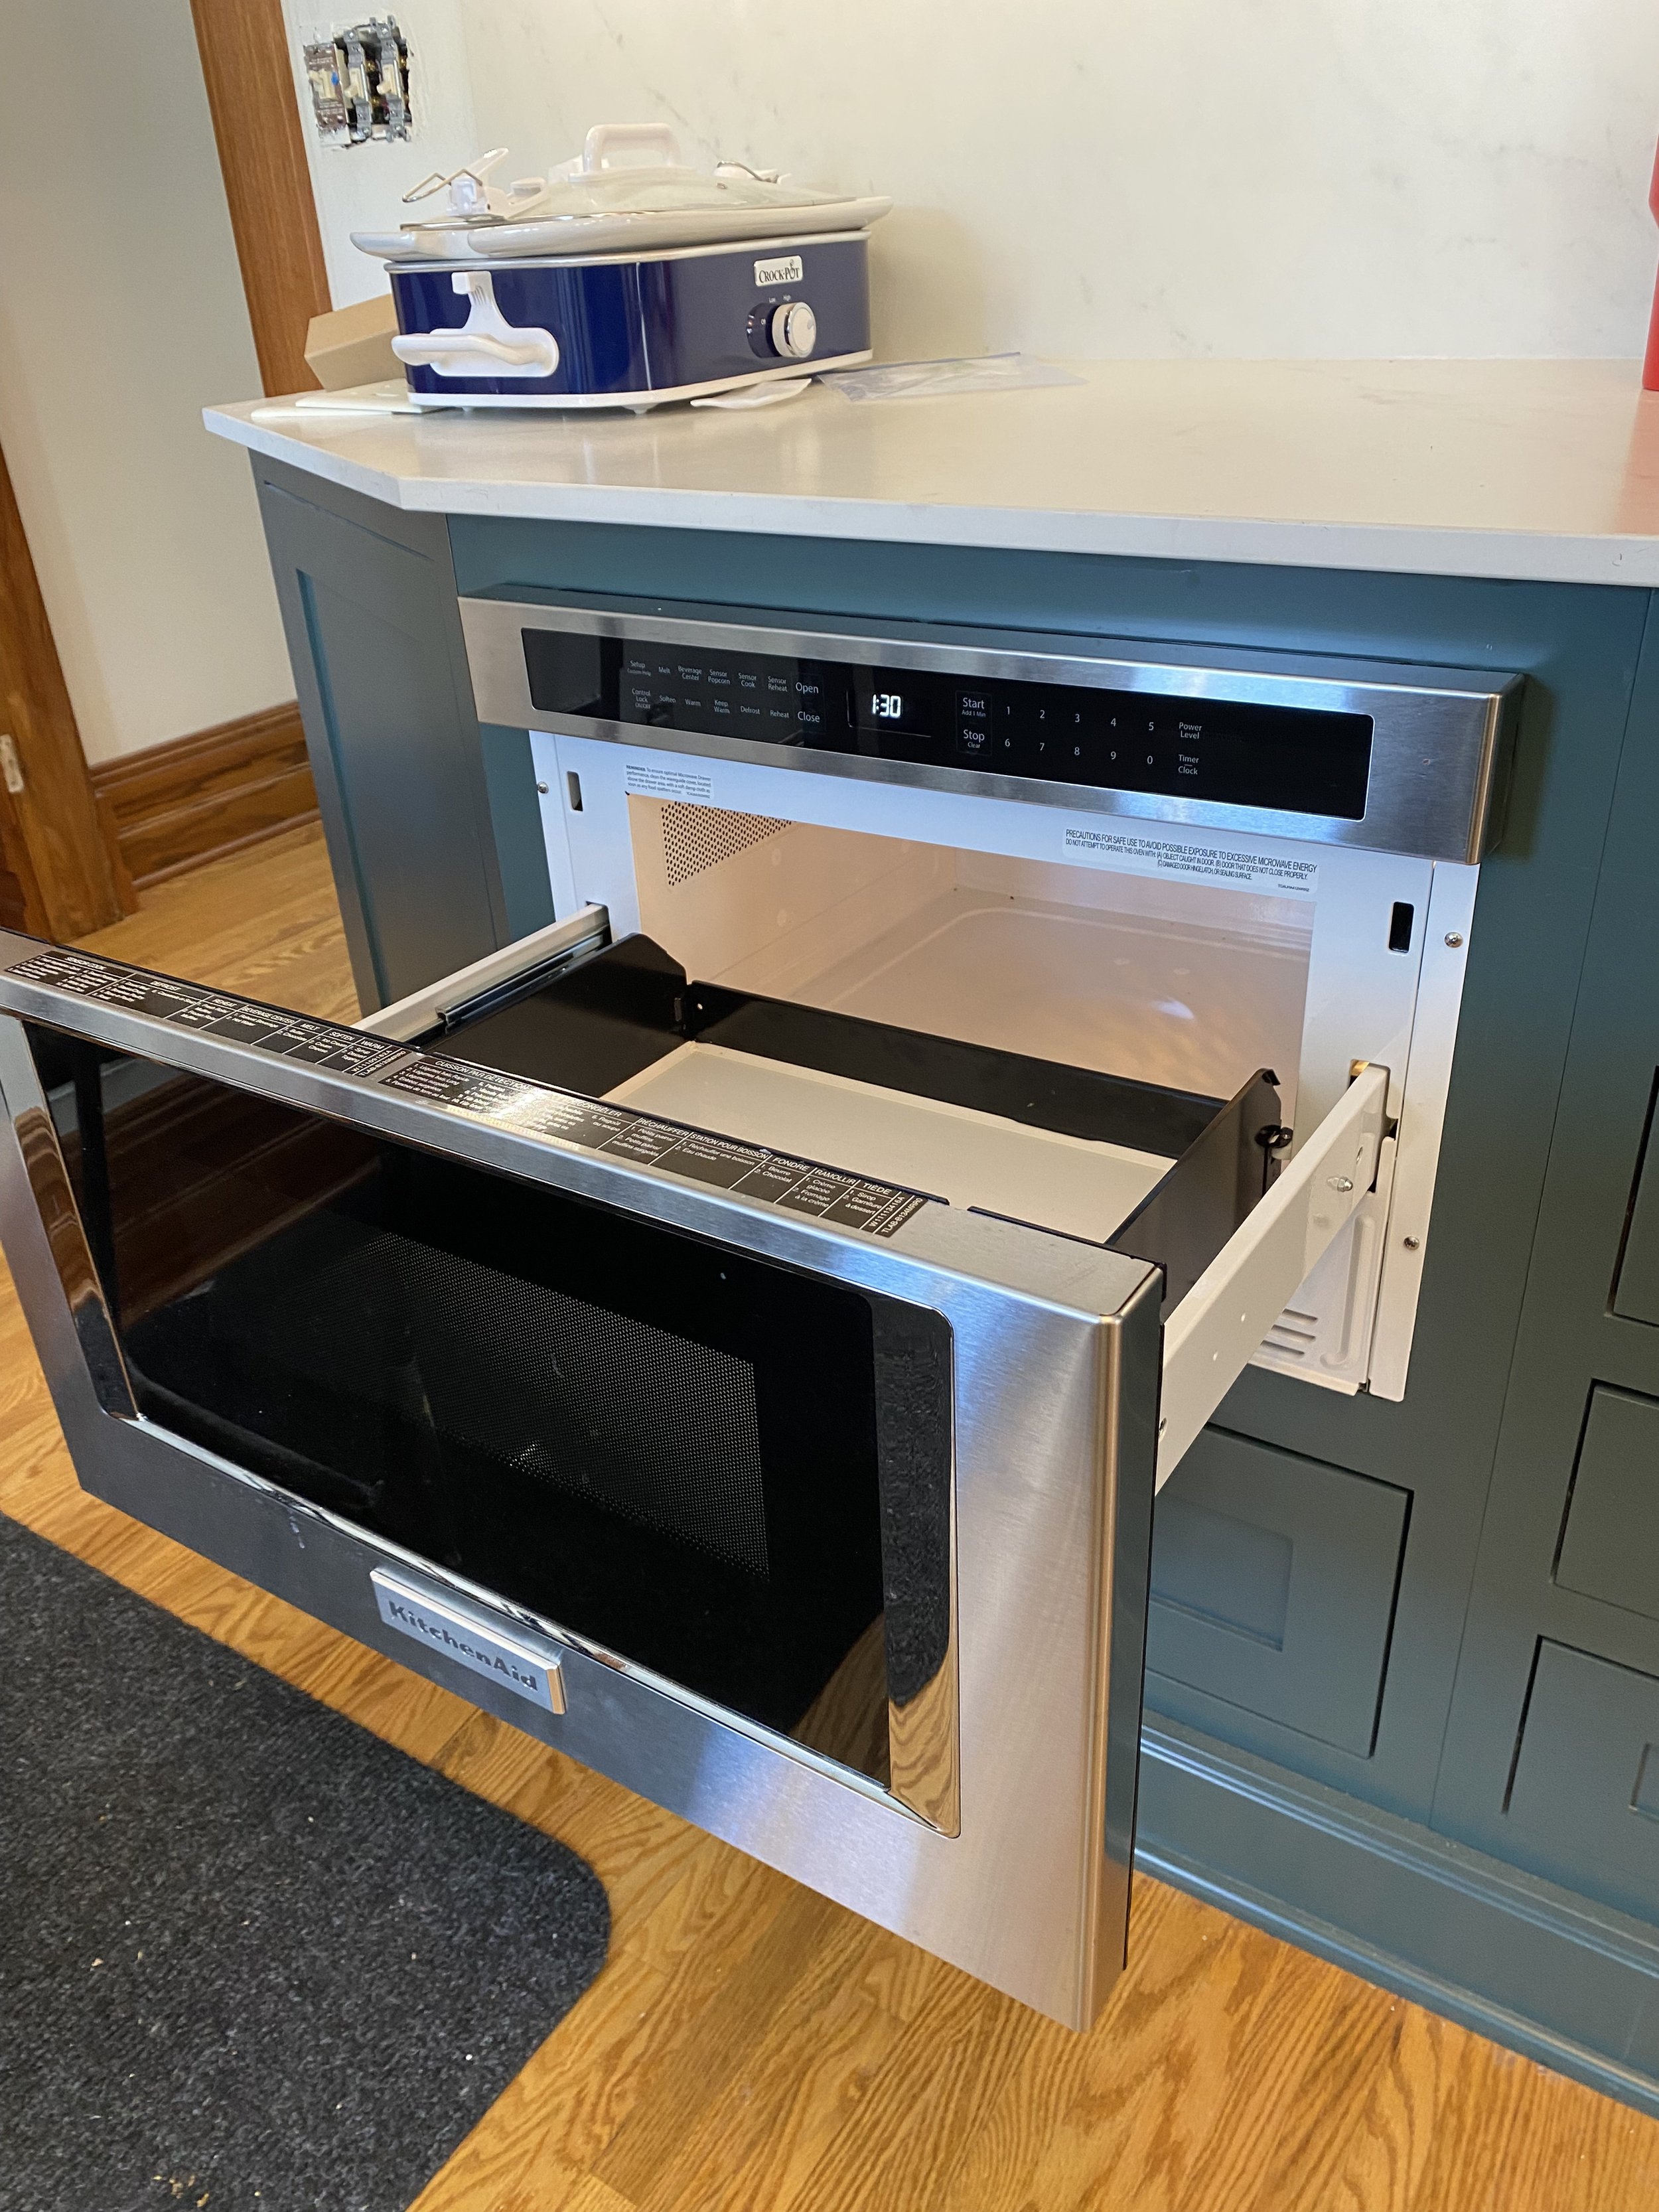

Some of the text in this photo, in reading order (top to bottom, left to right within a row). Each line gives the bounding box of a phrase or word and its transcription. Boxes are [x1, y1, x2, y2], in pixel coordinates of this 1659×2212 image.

[630, 660, 646, 669] Setup
[678, 665, 702, 676] Beverage
[707, 676, 730, 685] Popcorn
[739, 672, 757, 681] Sensor
[632, 688, 651, 696] Control
[768, 684, 788, 692] Reheat
[796, 682, 819, 694] Open
[871, 694, 902, 718] 1:30
[963, 698, 985, 709] Start
[741, 705, 760, 715] Defrost
[1007, 706, 1010, 715] 1
[1040, 709, 1045, 719] 2
[798, 711, 820, 723] Close
[1074, 713, 1080, 723] 3
[1110, 718, 1116, 727] 4
[1149, 722, 1154, 731] 5
[1179, 722, 1202, 731] Power
[964, 729, 985, 743] Stop
[1181, 730, 1200, 739] Level
[1005, 739, 1011, 747] 6
[1040, 743, 1045, 751] 7
[1074, 747, 1080, 755] 8
[1110, 751, 1116, 760] 9
[1147, 755, 1153, 764] 0
[1179, 754, 1199, 764] Timer
[1178, 767, 1198, 775] Clock
[1066, 829, 1317, 873] PRECAUTIONS FOR SAFE USE TO AVOID POSSIBLE EXPOSURE TO EXCESSIVE MICROWAVE ENERGY
[1081, 840, 1099, 849] ATTEMPT
[1106, 844, 1123, 853] OPERATE
[1163, 852, 1179, 861] OBJECT
[1179, 854, 1196, 863] CAUGHT
[1222, 861, 1235, 869] DOOR
[1269, 868, 1283, 877] CLOSE
[1163, 861, 1180, 869] DAMAGED
[150, 980, 182, 992] DEFROST
[300, 1023, 321, 1031] MELT
[329, 1031, 355, 1041] SOFTEN
[360, 1039, 385, 1050] WARM
[435, 1060, 469, 1073] CUISSON
[638, 1118, 689, 1136] RÉCHAUFFER
[690, 1134, 768, 1159] STATION POUR BOISSON
[694, 1151, 717, 1161] chaude
[731, 1155, 755, 1166] boisson
[772, 1157, 810, 1172] FONDRE
[768, 1165, 791, 1175] Beurre
[762, 1171, 792, 1183] Chocolat
[814, 1169, 857, 1185] RAMOLLIR
[812, 1179, 836, 1189] Crème
[863, 1182, 892, 1195] TIÈDE
[806, 1184, 831, 1195] glacée
[800, 1189, 830, 1202] Fromage
[857, 1192, 877, 1201] Sirop
[808, 1199, 830, 1208] crème
[851, 1197, 883, 1210] Garniture
[851, 1204, 877, 1215] dessert
[388, 1599, 539, 1692] KitchenAid
